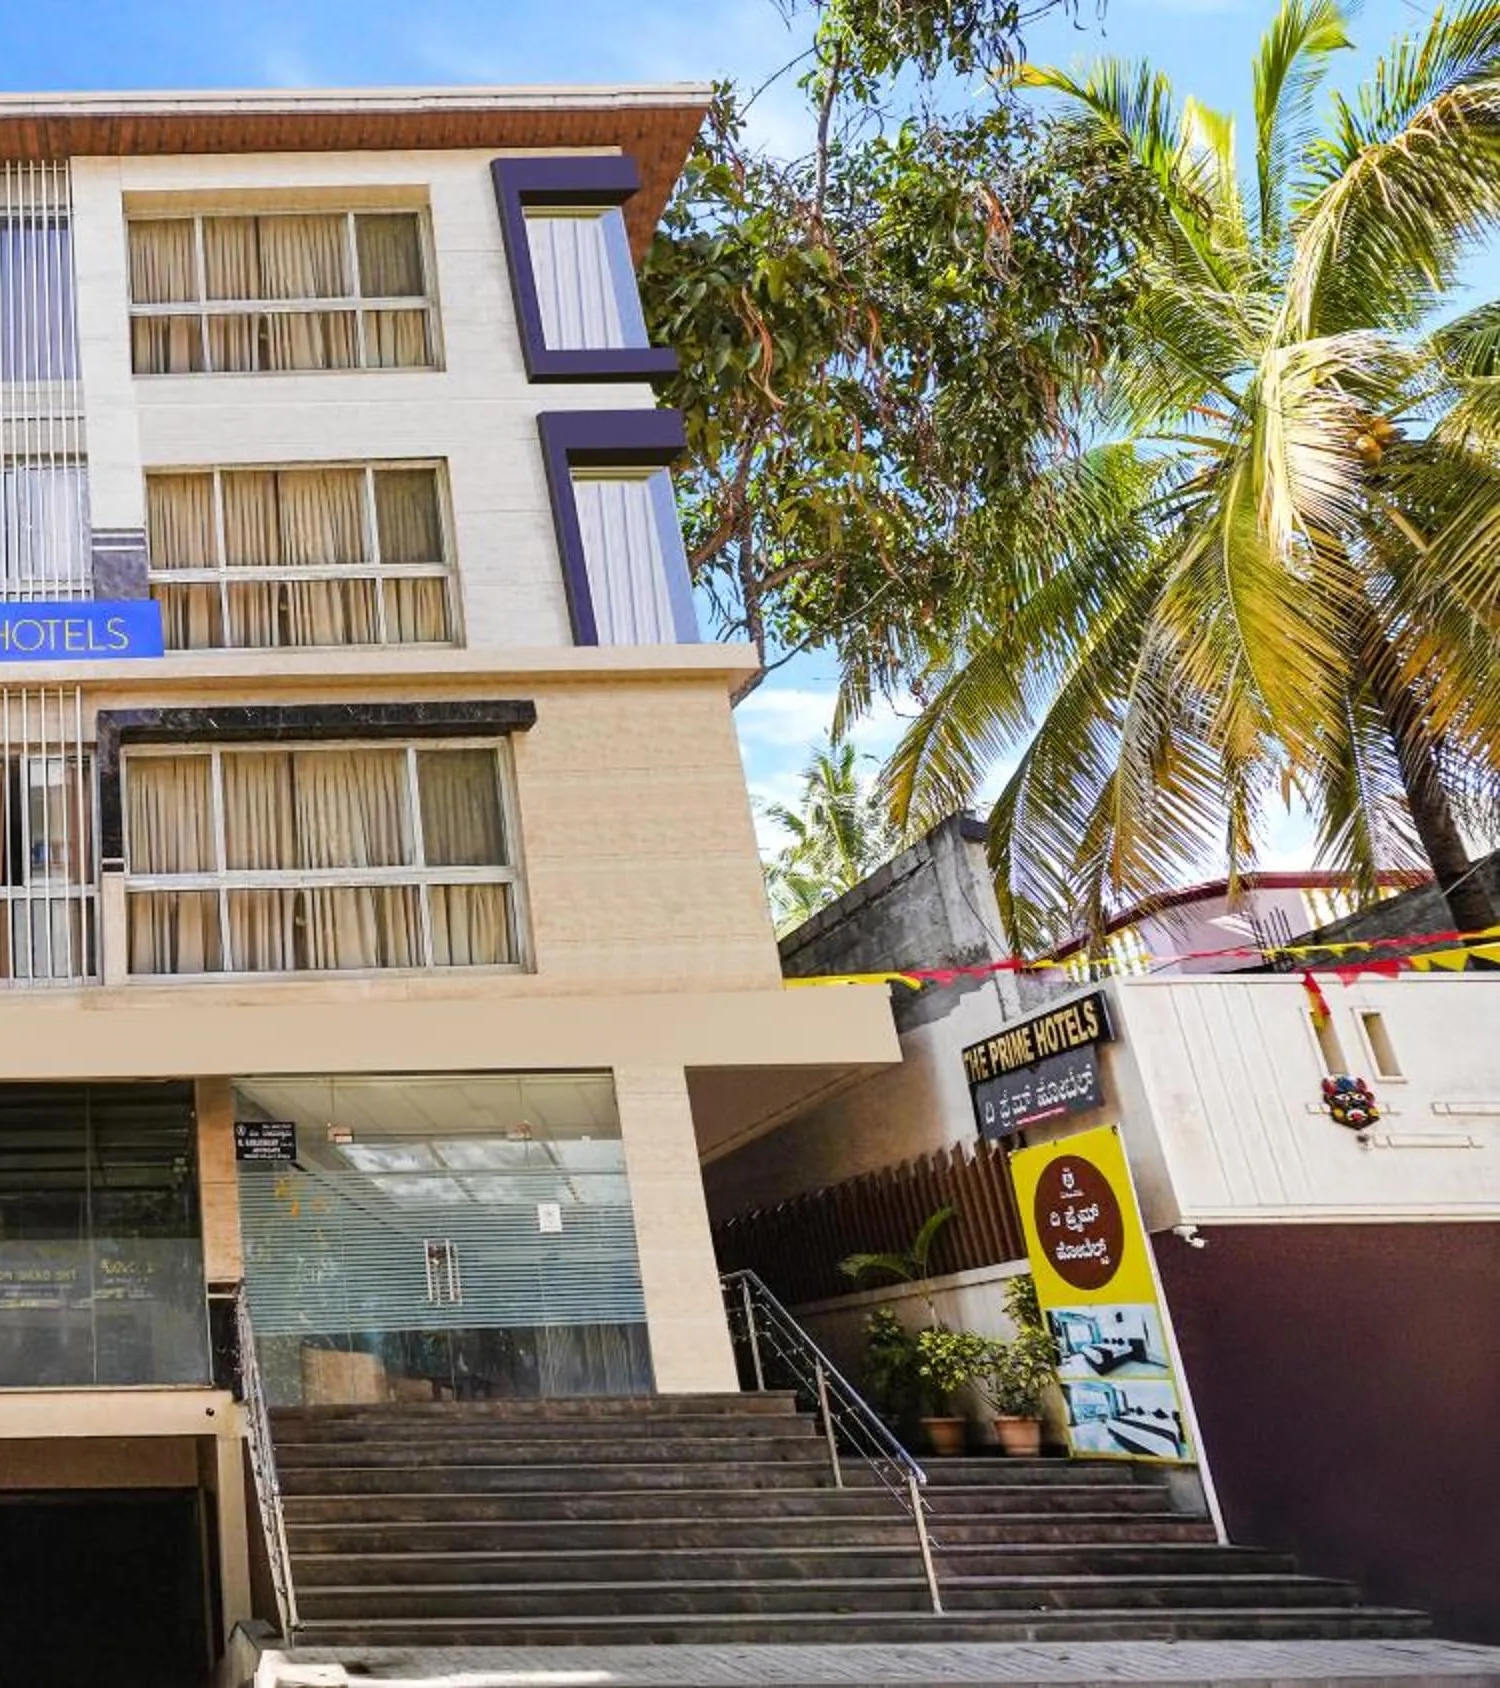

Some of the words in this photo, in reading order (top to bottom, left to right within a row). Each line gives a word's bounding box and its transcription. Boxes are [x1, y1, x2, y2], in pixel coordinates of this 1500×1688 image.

[963, 1045, 990, 1081] THE
[988, 1027, 1035, 1075] PRIME
[1033, 1000, 1100, 1056] HOTELS
